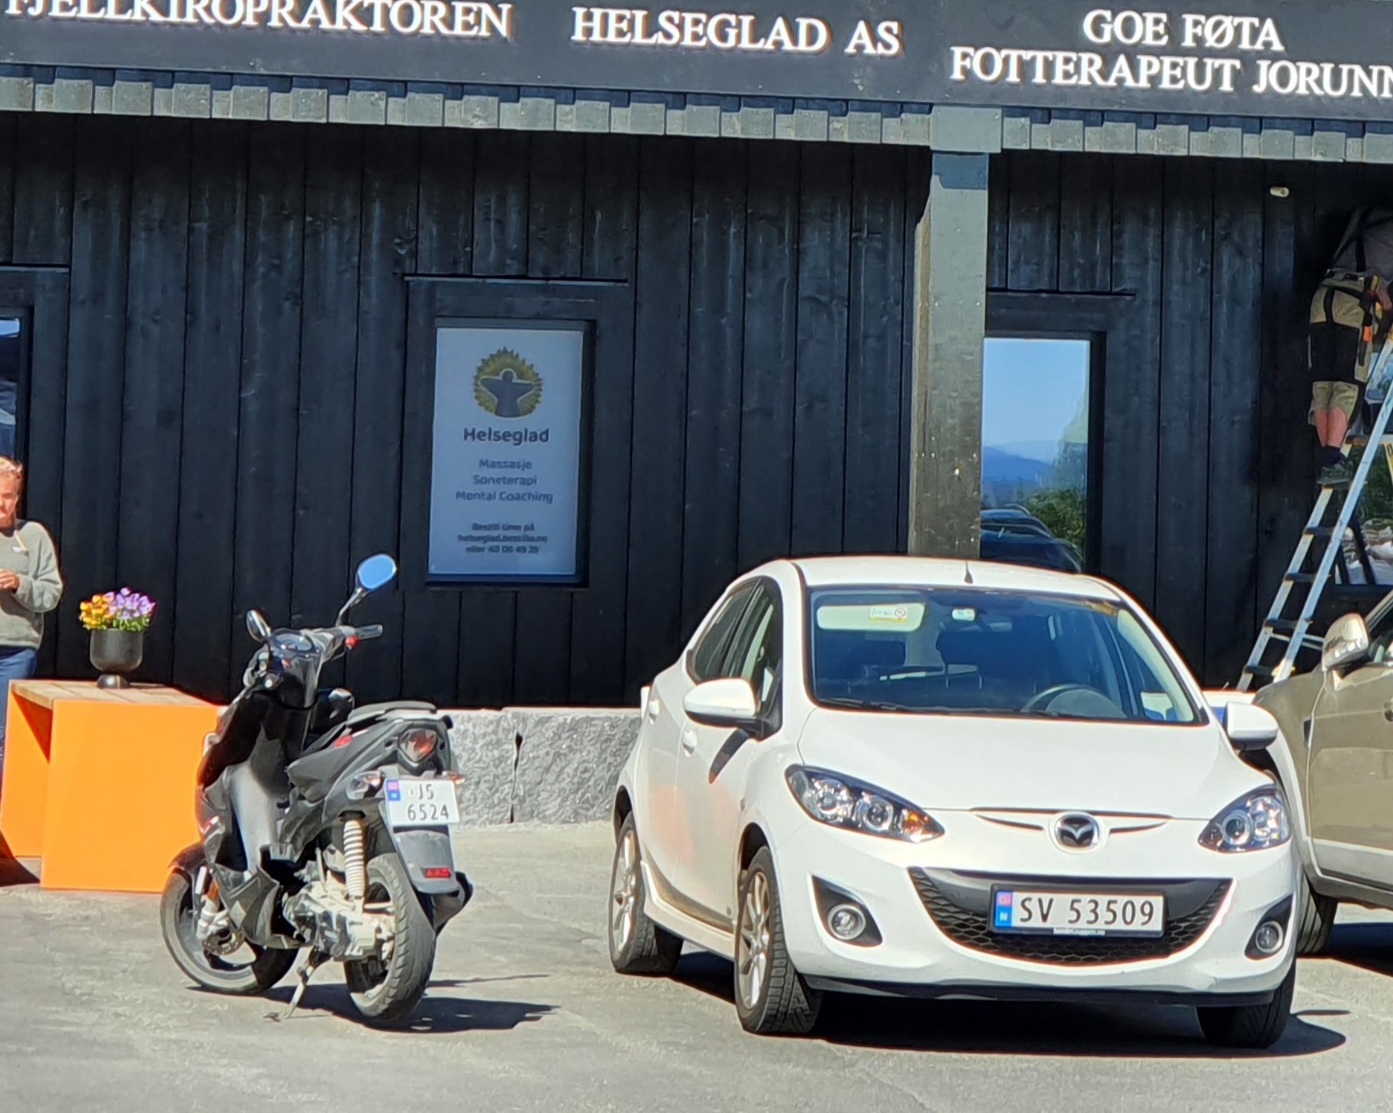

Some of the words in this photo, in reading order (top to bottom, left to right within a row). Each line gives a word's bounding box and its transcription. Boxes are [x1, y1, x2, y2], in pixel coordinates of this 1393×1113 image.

[570, 6, 829, 53] HELSEGLAD
[844, 20, 901, 57] AS
[1082, 8, 1169, 47] GOE
[1180, 12, 1285, 53] FØTA
[949, 45, 1241, 93] FOTTERAPEUT
[463, 427, 550, 446] Helseglad
[478, 459, 533, 471] Massasje
[455, 490, 496, 501] Mental
[499, 491, 554, 505] Coaching
[418, 783, 435, 801] JS
[407, 803, 450, 822] 6524
[1019, 896, 1054, 924] SV
[1067, 898, 1155, 927] 53509
